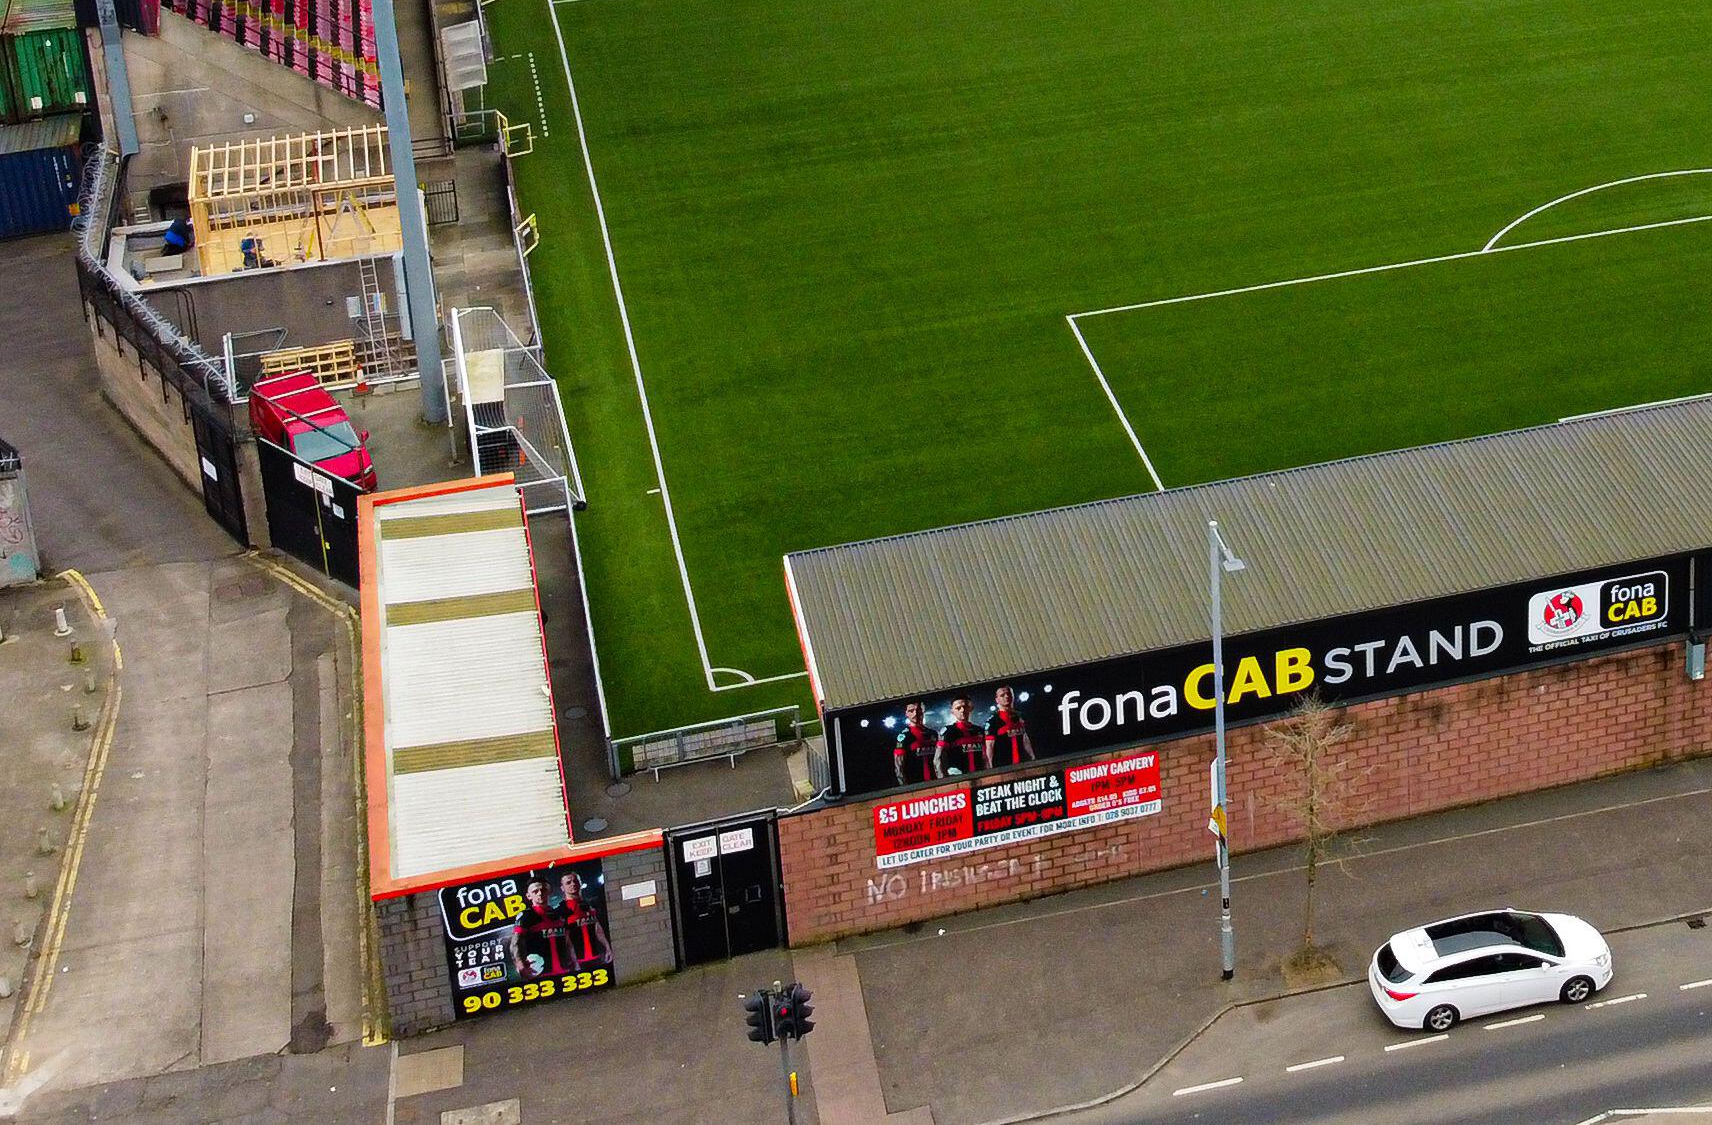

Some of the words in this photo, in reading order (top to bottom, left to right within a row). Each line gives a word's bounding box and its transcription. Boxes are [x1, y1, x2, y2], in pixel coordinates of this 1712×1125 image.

[1610, 582, 1656, 604] fona
[1607, 597, 1658, 623] CAB
[1529, 645, 1544, 654] THE
[1544, 638, 1581, 652] OFFICIAL
[1581, 634, 1599, 644] TAXI
[1599, 631, 1611, 641] OF
[1611, 623, 1658, 639] CRUSADERS
[1657, 620, 1669, 629] FC
[1323, 619, 1505, 686] STAND
[1069, 763, 1110, 784] SUNDAY
[1110, 754, 1156, 776] CARVERY
[976, 799, 1005, 818] BEAT
[1005, 795, 1028, 812] THE
[1028, 787, 1064, 810] CLOCK
[977, 784, 1013, 803] STEAK
[1013, 779, 1048, 798] NIGHT
[1049, 775, 1060, 789] &
[878, 806, 899, 825] £5
[901, 793, 967, 821] LUNCHES
[883, 820, 925, 839] MONDAY
[929, 814, 964, 830] FRIDAY
[976, 816, 1013, 834] FRIDAY
[688, 845, 716, 860] KEEP
[691, 838, 714, 852] EXIT
[721, 832, 748, 846] GATE
[722, 837, 753, 853] CLEAR
[882, 855, 898, 867] LET
[898, 852, 910, 863] US
[910, 848, 935, 862] CATER
[936, 845, 952, 857] FOR
[952, 840, 974, 853] YOUR
[974, 835, 999, 849] PARTY
[1000, 832, 1012, 843] OR
[1039, 823, 1055, 835] FOR
[1056, 819, 1078, 830] MORE
[1078, 815, 1097, 827] INFO
[456, 878, 518, 910] fona
[867, 874, 907, 906] NO
[459, 894, 528, 931] CAB
[454, 937, 505, 955] SUPPORT
[456, 944, 505, 963] YOUR
[456, 951, 506, 969] TEAM
[463, 991, 502, 1014] 90
[507, 980, 556, 1005] 333
[562, 967, 610, 994] 333
